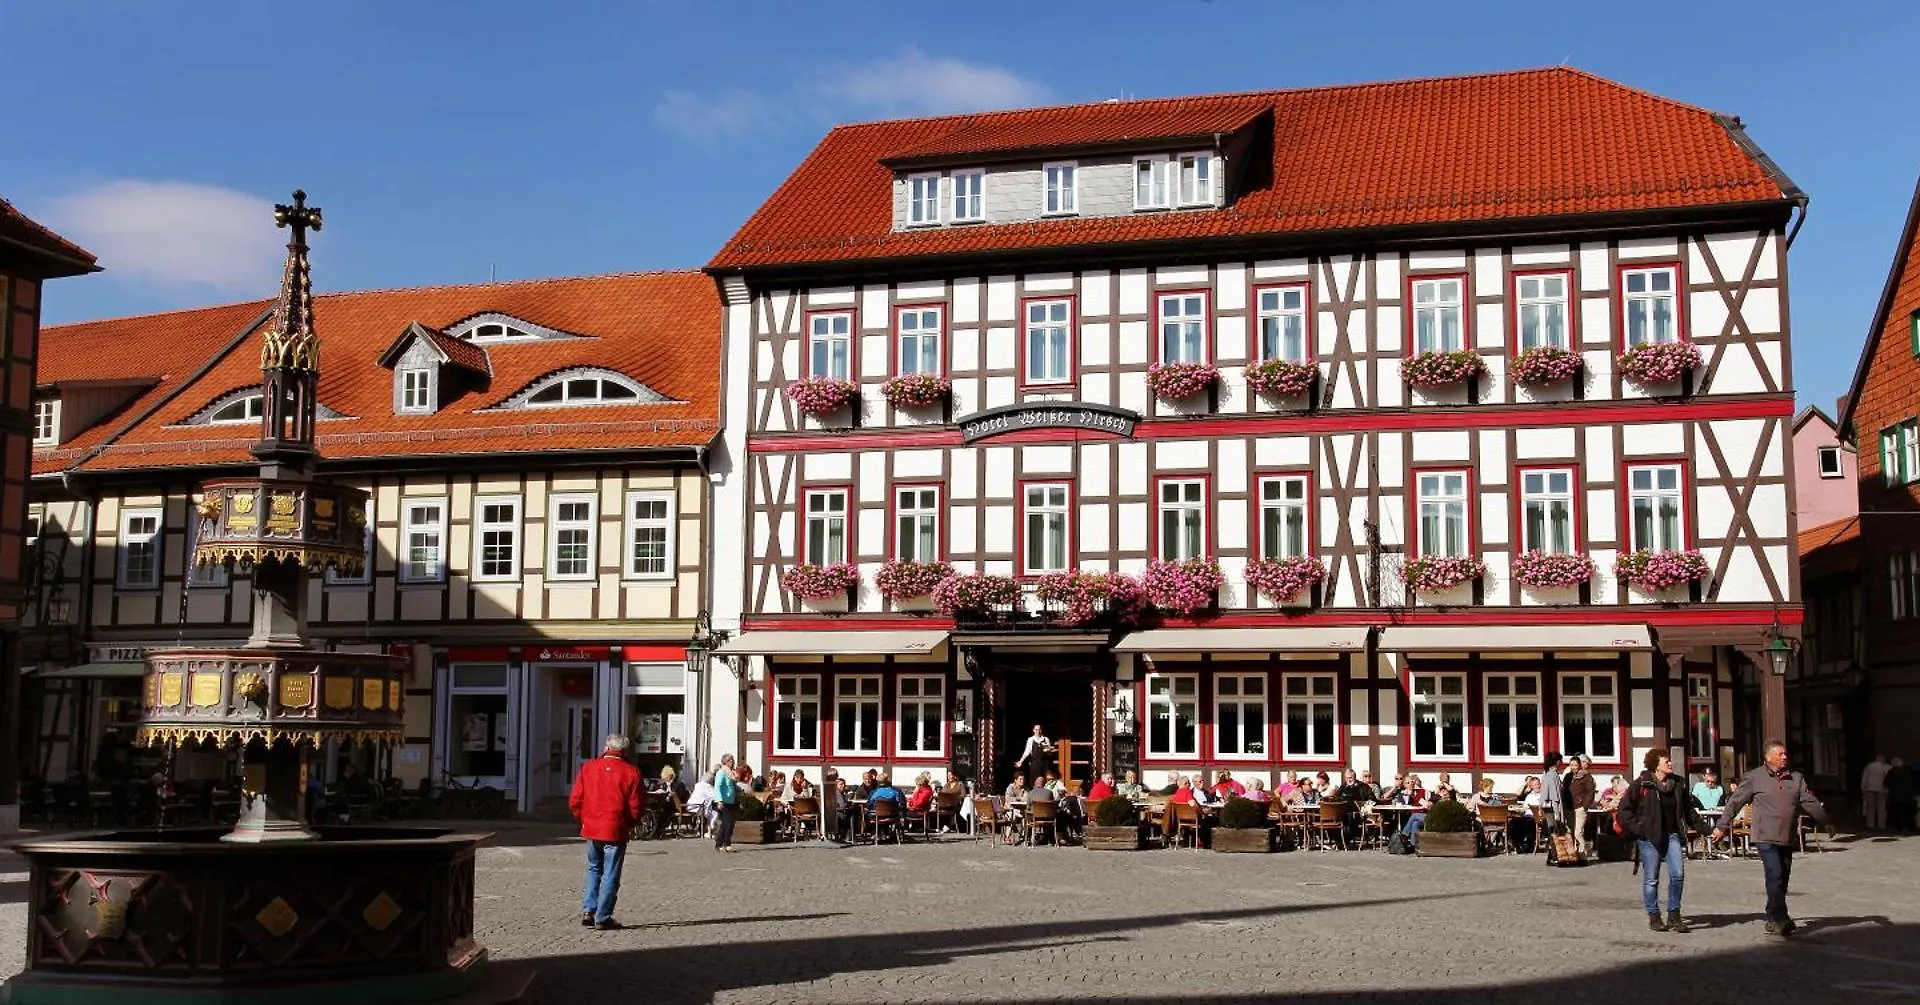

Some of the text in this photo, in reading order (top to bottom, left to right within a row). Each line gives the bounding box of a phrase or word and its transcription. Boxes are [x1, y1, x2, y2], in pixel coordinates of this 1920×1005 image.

[966, 414, 1009, 436] Hotel
[1079, 411, 1127, 432] Hirsch
[552, 649, 592, 660] Santander
